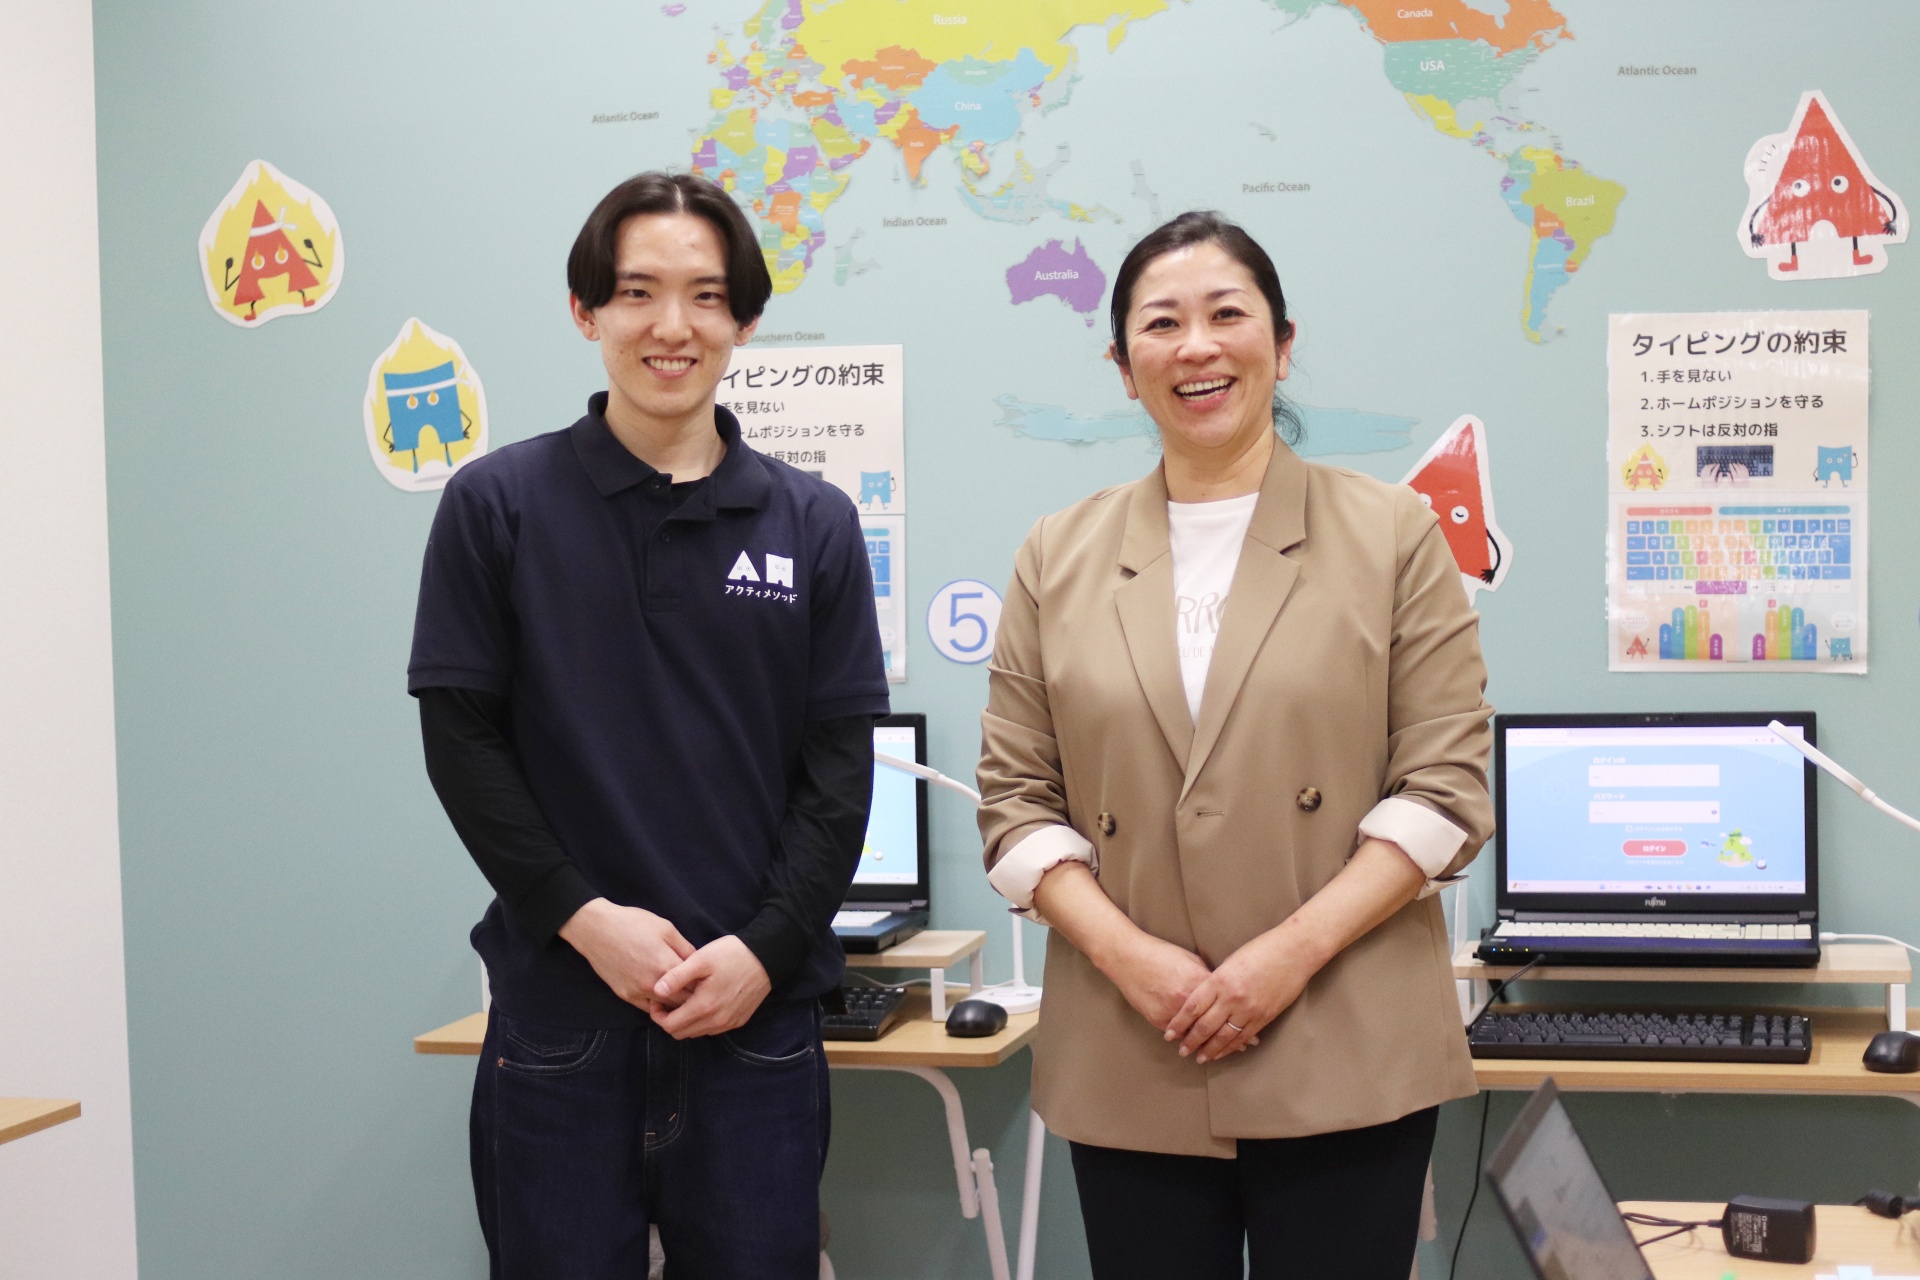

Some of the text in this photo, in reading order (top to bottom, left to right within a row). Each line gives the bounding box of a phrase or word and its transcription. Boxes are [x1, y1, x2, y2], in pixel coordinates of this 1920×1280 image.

[933, 14, 968, 25] Russia
[1397, 8, 1433, 19] Canada
[1420, 60, 1445, 72] USA
[1617, 64, 1697, 76] Atlantic Ocean
[954, 102, 982, 111] China
[592, 112, 660, 124] Atlantic Ocean
[1242, 182, 1310, 194] Pacific Ocean
[1566, 195, 1595, 207] Brazil
[882, 216, 948, 228] Indian Ocean
[1034, 268, 1079, 282] Australia
[794, 332, 825, 341] Ocean
[1632, 328, 1848, 357] タイピングの約束
[742, 424, 866, 440] ムポジションを守る
[762, 449, 827, 464] 反対の指
[724, 584, 798, 604] アクティメソッド
[948, 592, 988, 653] 5
[1644, 896, 1666, 906] FUJITSU
